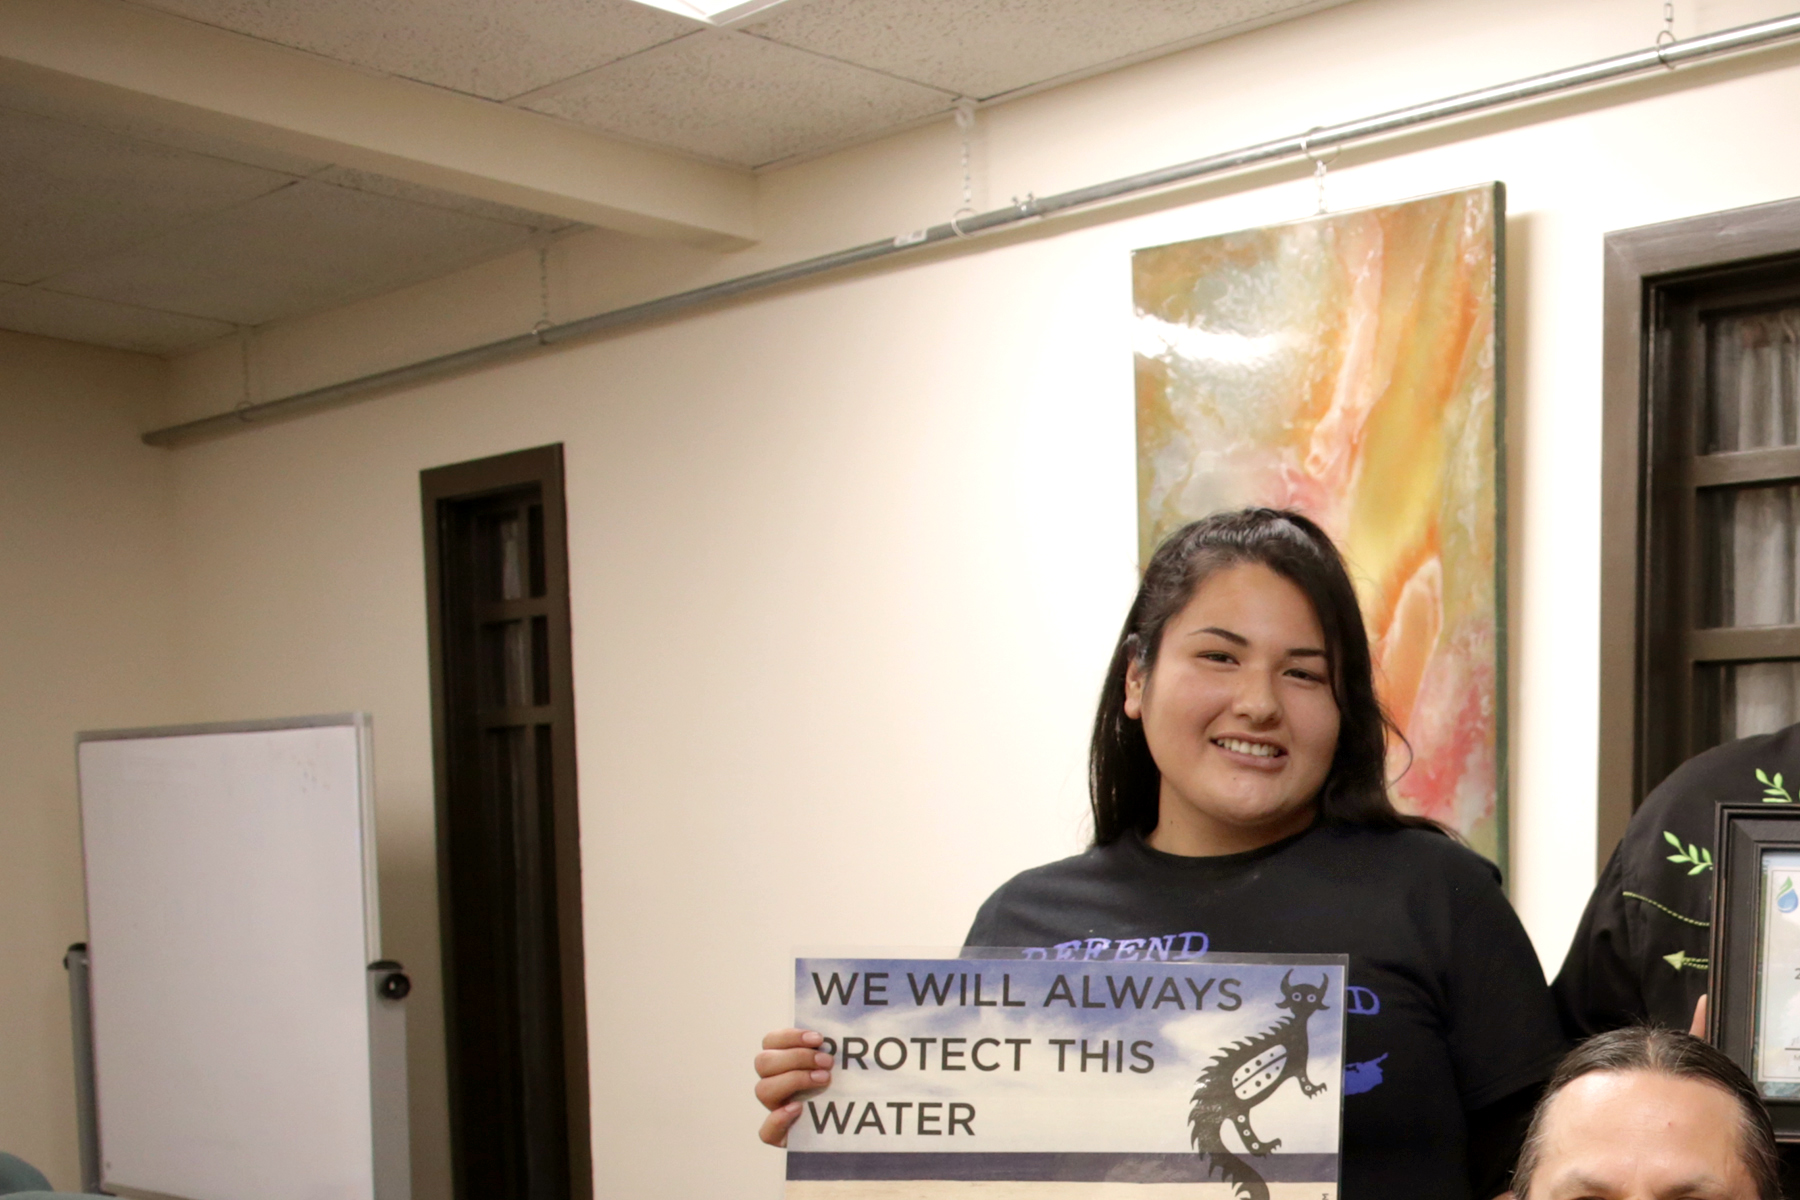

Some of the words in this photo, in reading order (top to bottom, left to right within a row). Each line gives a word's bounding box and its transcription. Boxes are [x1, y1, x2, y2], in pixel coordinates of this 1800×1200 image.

[811, 972, 890, 1006] WE
[906, 972, 1026, 1007] WILL
[1042, 974, 1243, 1012] ALWAYS
[1048, 1038, 1155, 1074] THIS
[807, 1101, 976, 1136] WATER
